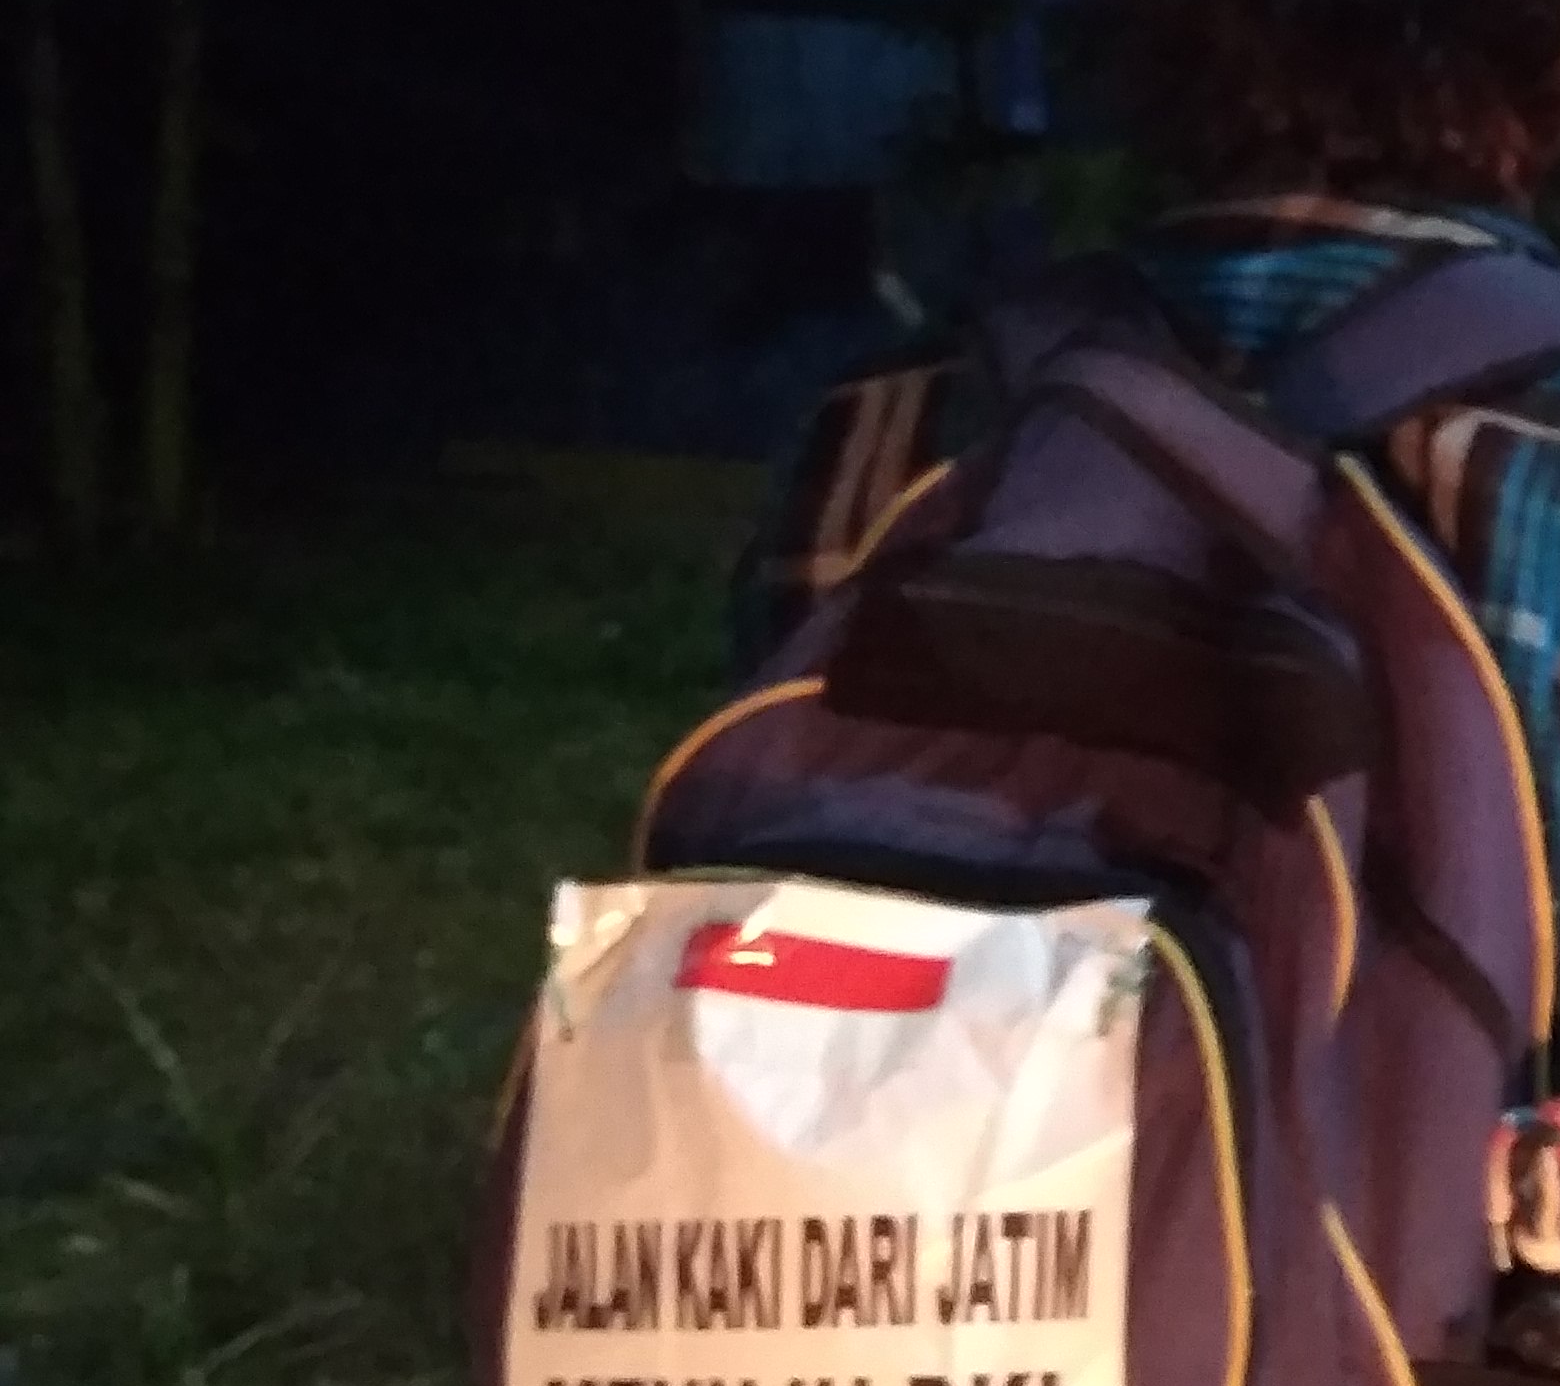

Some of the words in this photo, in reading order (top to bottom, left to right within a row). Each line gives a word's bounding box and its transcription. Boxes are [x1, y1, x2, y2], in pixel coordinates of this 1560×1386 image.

[534, 1221, 661, 1331] JALAN
[676, 1218, 781, 1330] KAKI
[801, 1213, 919, 1329] DARI
[936, 1209, 1092, 1324] JATIM
